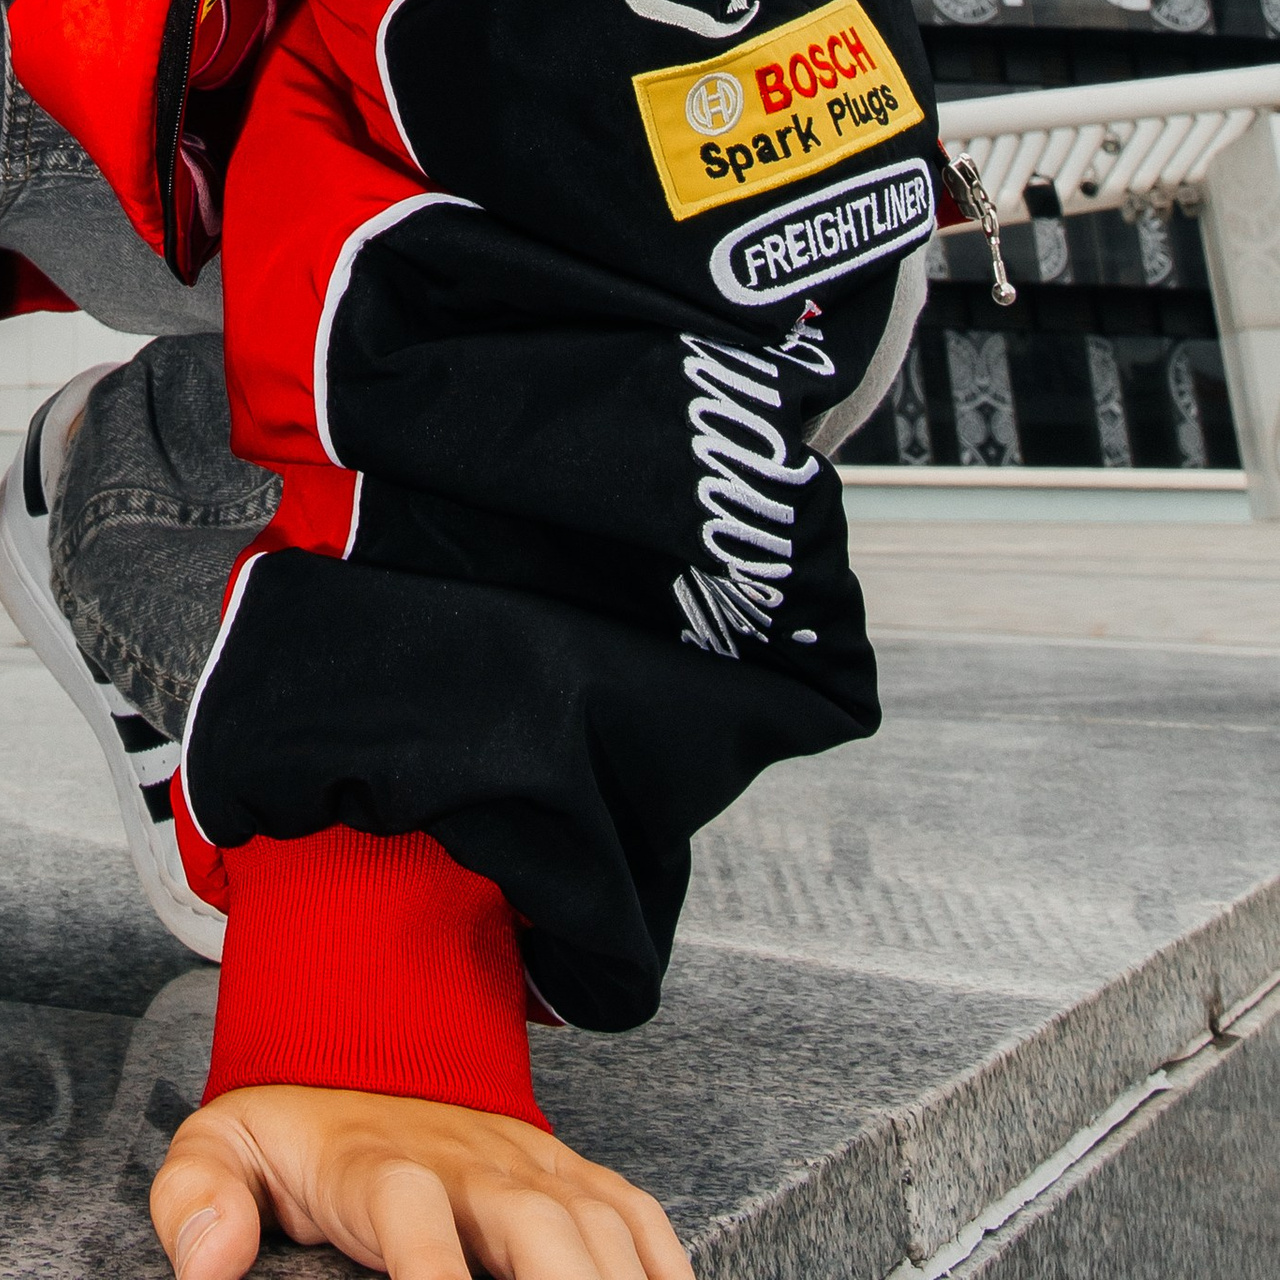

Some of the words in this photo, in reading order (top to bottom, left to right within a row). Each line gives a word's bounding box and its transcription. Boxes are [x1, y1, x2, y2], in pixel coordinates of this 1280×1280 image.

[756, 26, 877, 116] BOSCH
[699, 113, 823, 184] Spark
[831, 80, 900, 140] Plugs
[744, 175, 928, 288] FREIGHTLINER
